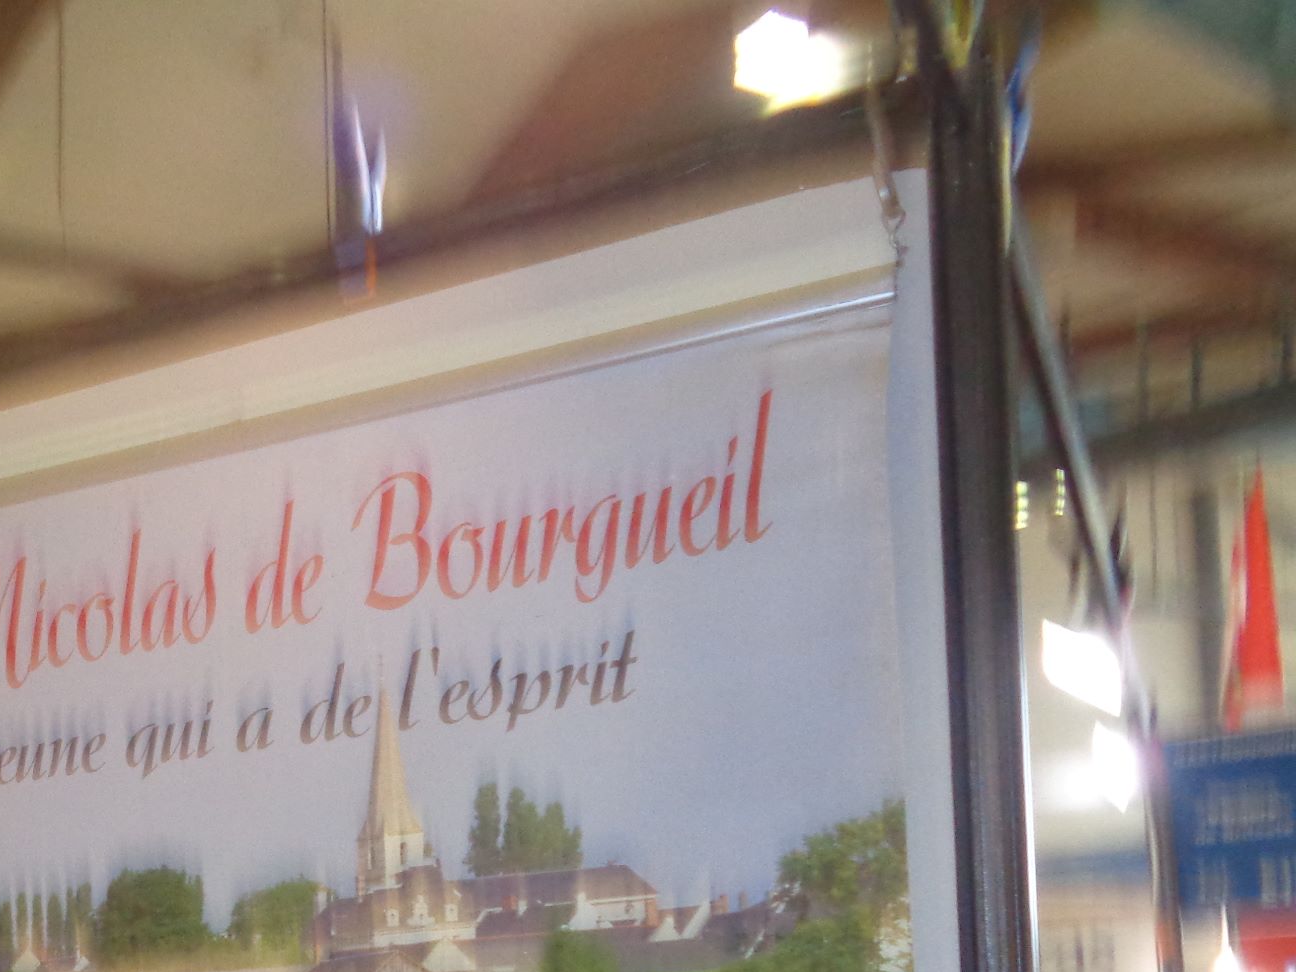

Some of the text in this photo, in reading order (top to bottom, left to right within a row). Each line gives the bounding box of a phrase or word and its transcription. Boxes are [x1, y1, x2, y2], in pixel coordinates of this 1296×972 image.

[244, 500, 324, 634] de
[351, 390, 772, 610] Bourgueil
[126, 700, 215, 779] qui
[236, 706, 274, 752] a
[299, 663, 372, 744] de
[398, 630, 639, 732] l'esprit
